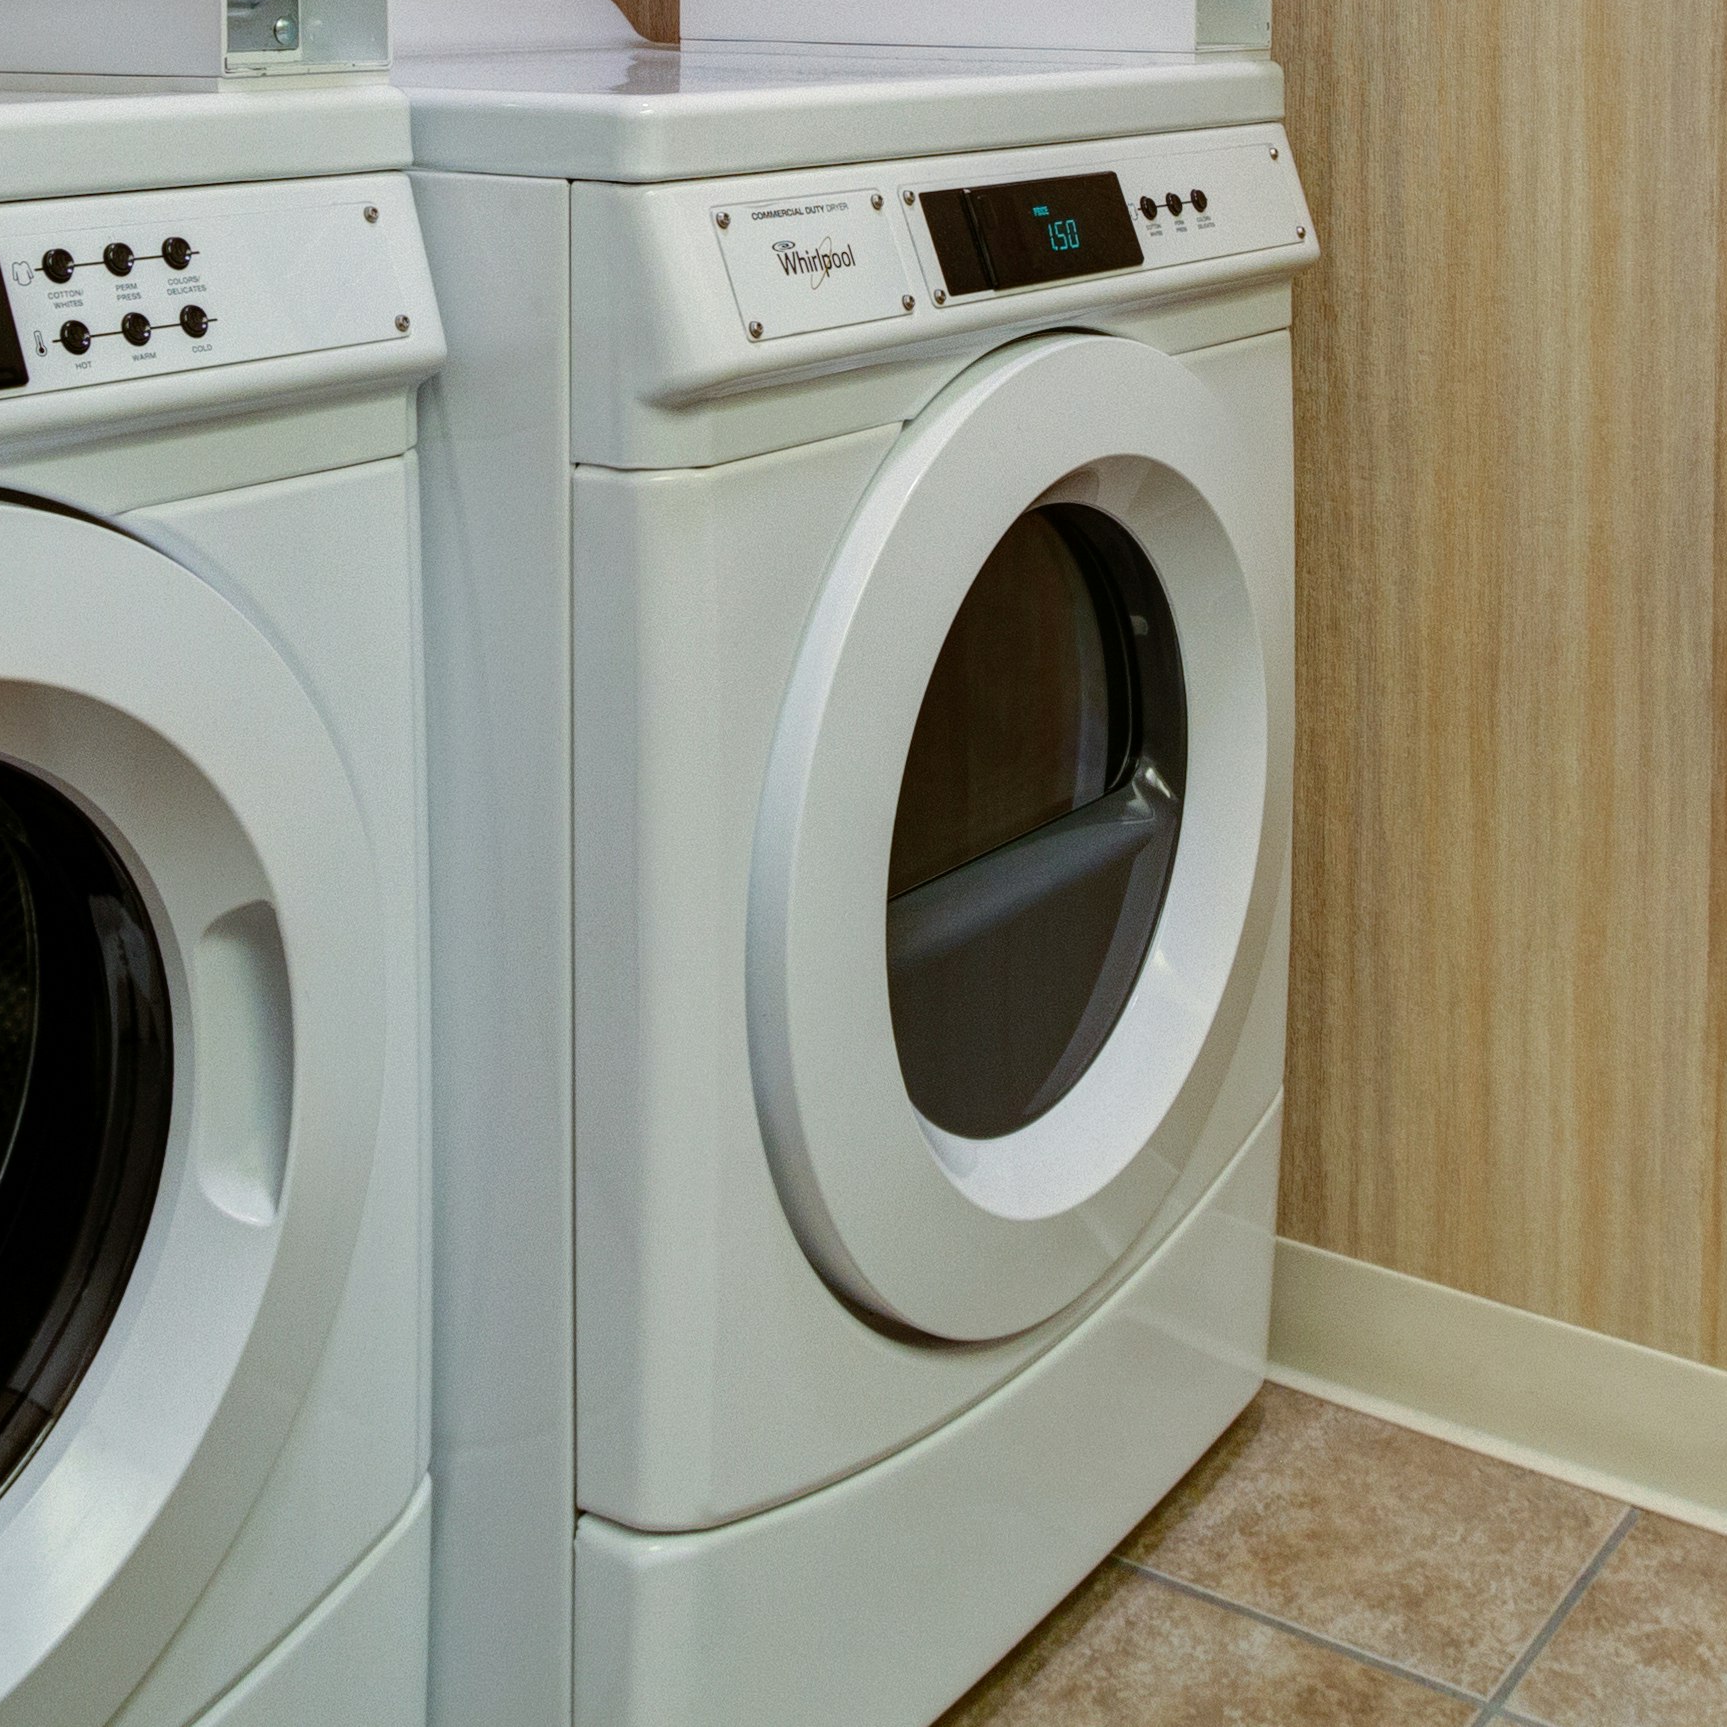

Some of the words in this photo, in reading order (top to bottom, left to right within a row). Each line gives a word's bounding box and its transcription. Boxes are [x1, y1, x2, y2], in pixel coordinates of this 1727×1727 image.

[751, 206, 804, 221] COMMERCIAL
[805, 204, 825, 215] DUTY
[776, 244, 856, 278] Whirlpool
[115, 282, 138, 292] PERM
[166, 284, 207, 296] DELICATES
[116, 292, 142, 301] PRESS
[53, 300, 84, 310] WHITES
[191, 344, 213, 354] COLD
[132, 352, 157, 362] WARM
[75, 361, 92, 370] HOT
